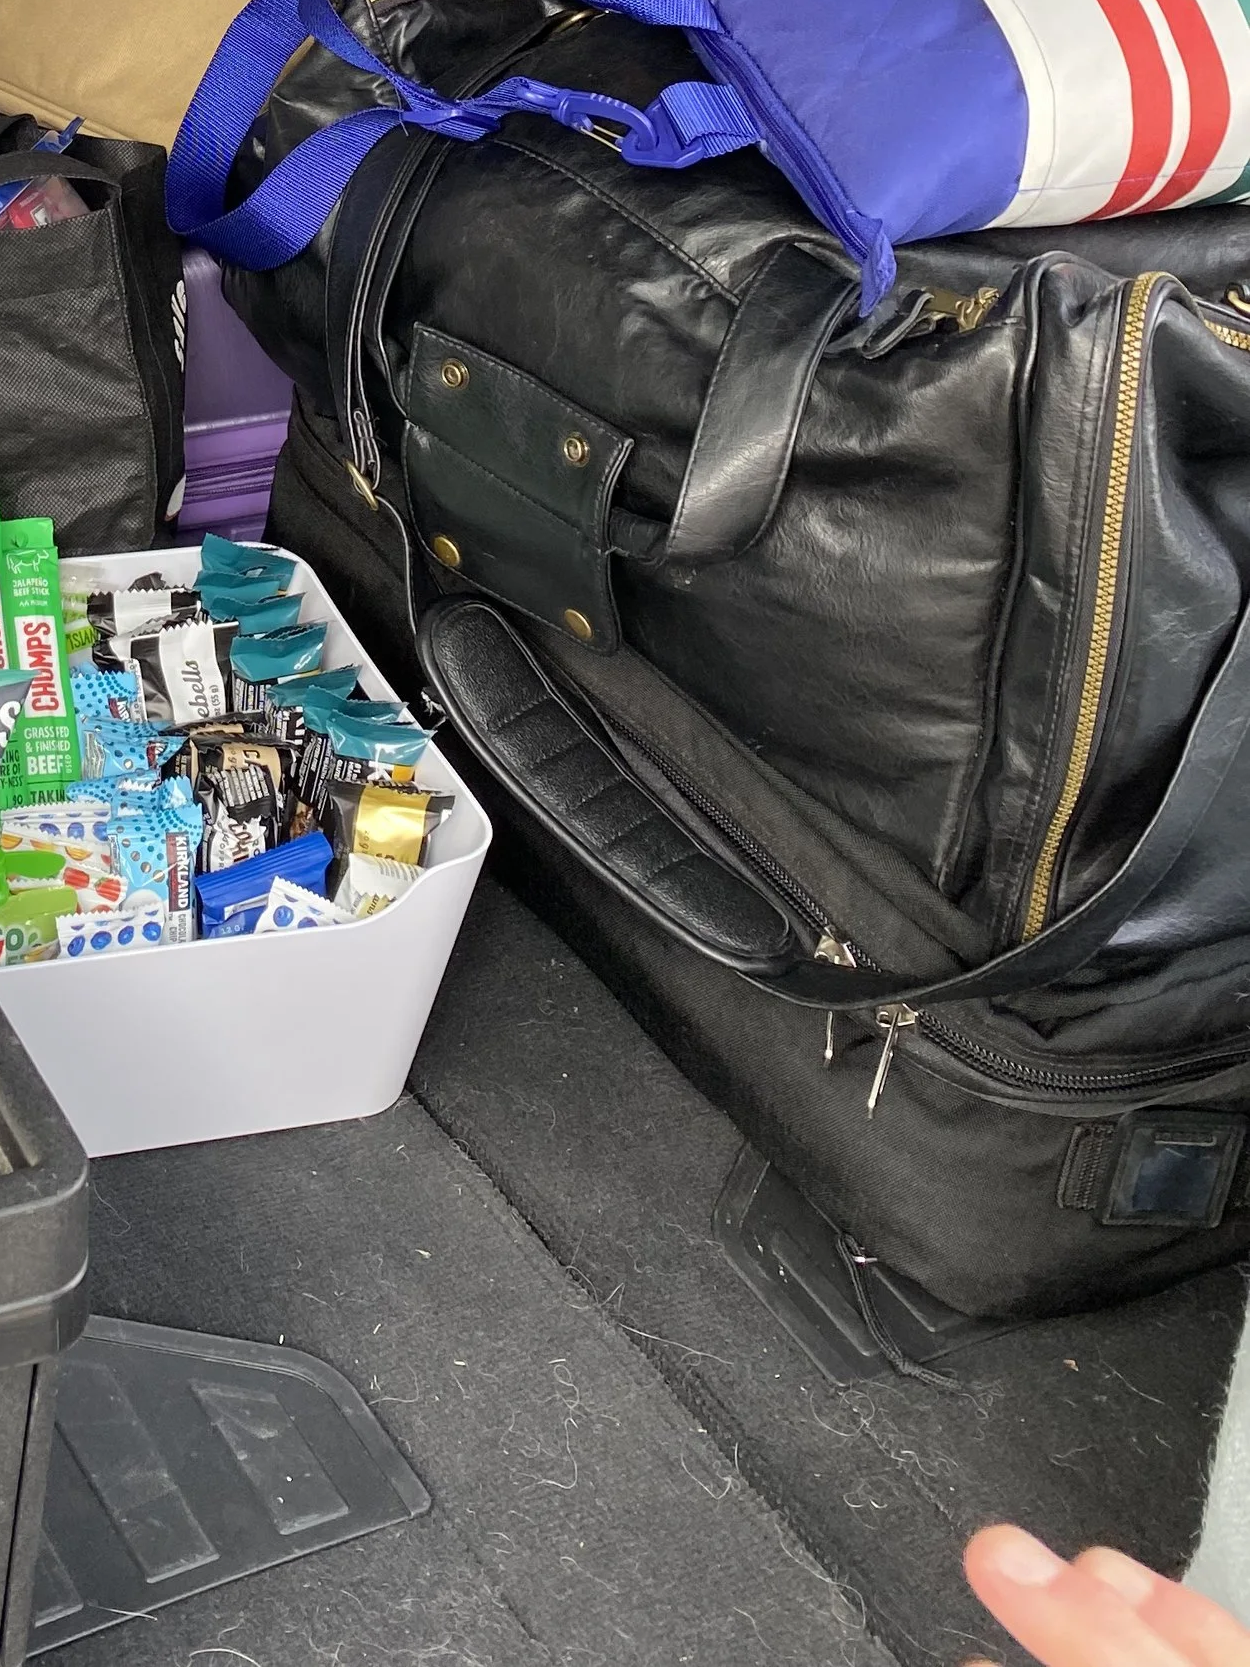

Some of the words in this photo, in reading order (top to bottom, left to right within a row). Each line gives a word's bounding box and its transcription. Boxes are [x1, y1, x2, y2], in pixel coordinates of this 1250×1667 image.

[13, 577, 49, 589] JALAPEÑO
[13, 587, 31, 597] BEEF
[32, 586, 50, 596] STICK
[24, 621, 60, 712] CHOMPS
[24, 725, 53, 740] GRASS
[54, 725, 70, 738] FED
[25, 742, 33, 754] &
[35, 739, 71, 753] FINISHED
[27, 754, 64, 776] BEEF
[176, 834, 191, 909] KIRKLAND
